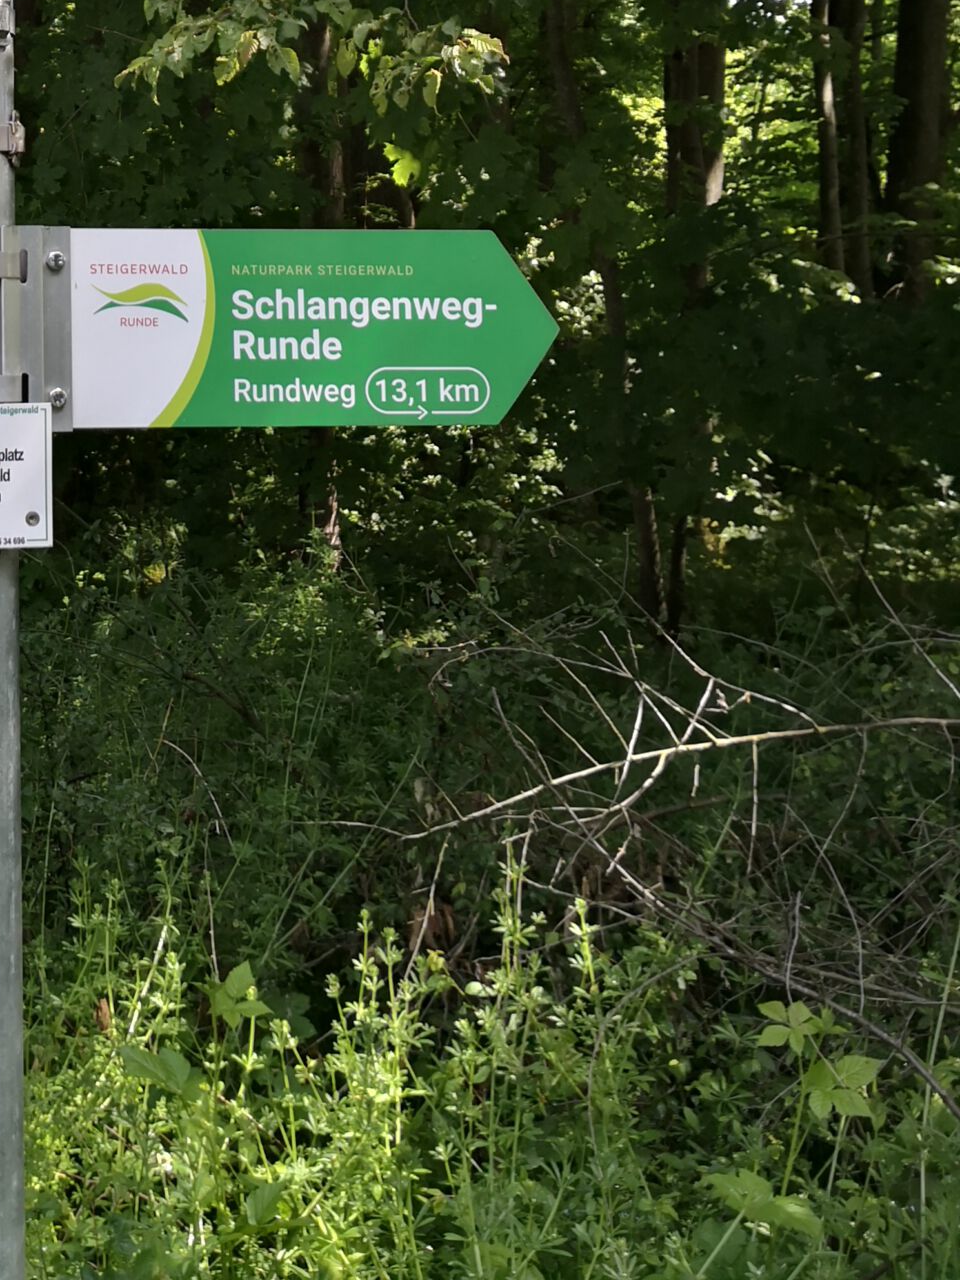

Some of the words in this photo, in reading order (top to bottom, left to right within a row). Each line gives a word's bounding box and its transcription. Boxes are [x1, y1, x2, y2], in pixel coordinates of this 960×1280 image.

[90, 263, 189, 274] STEIGERWALD
[232, 264, 313, 276] NATURPARK
[318, 265, 413, 277] STEIGERWALD
[232, 289, 497, 329] Schlangenweg-
[120, 317, 159, 327] RUNDE
[232, 331, 342, 360] Runde
[234, 379, 355, 408] Rundweg
[375, 379, 427, 407] 13,1
[440, 379, 479, 403] km
